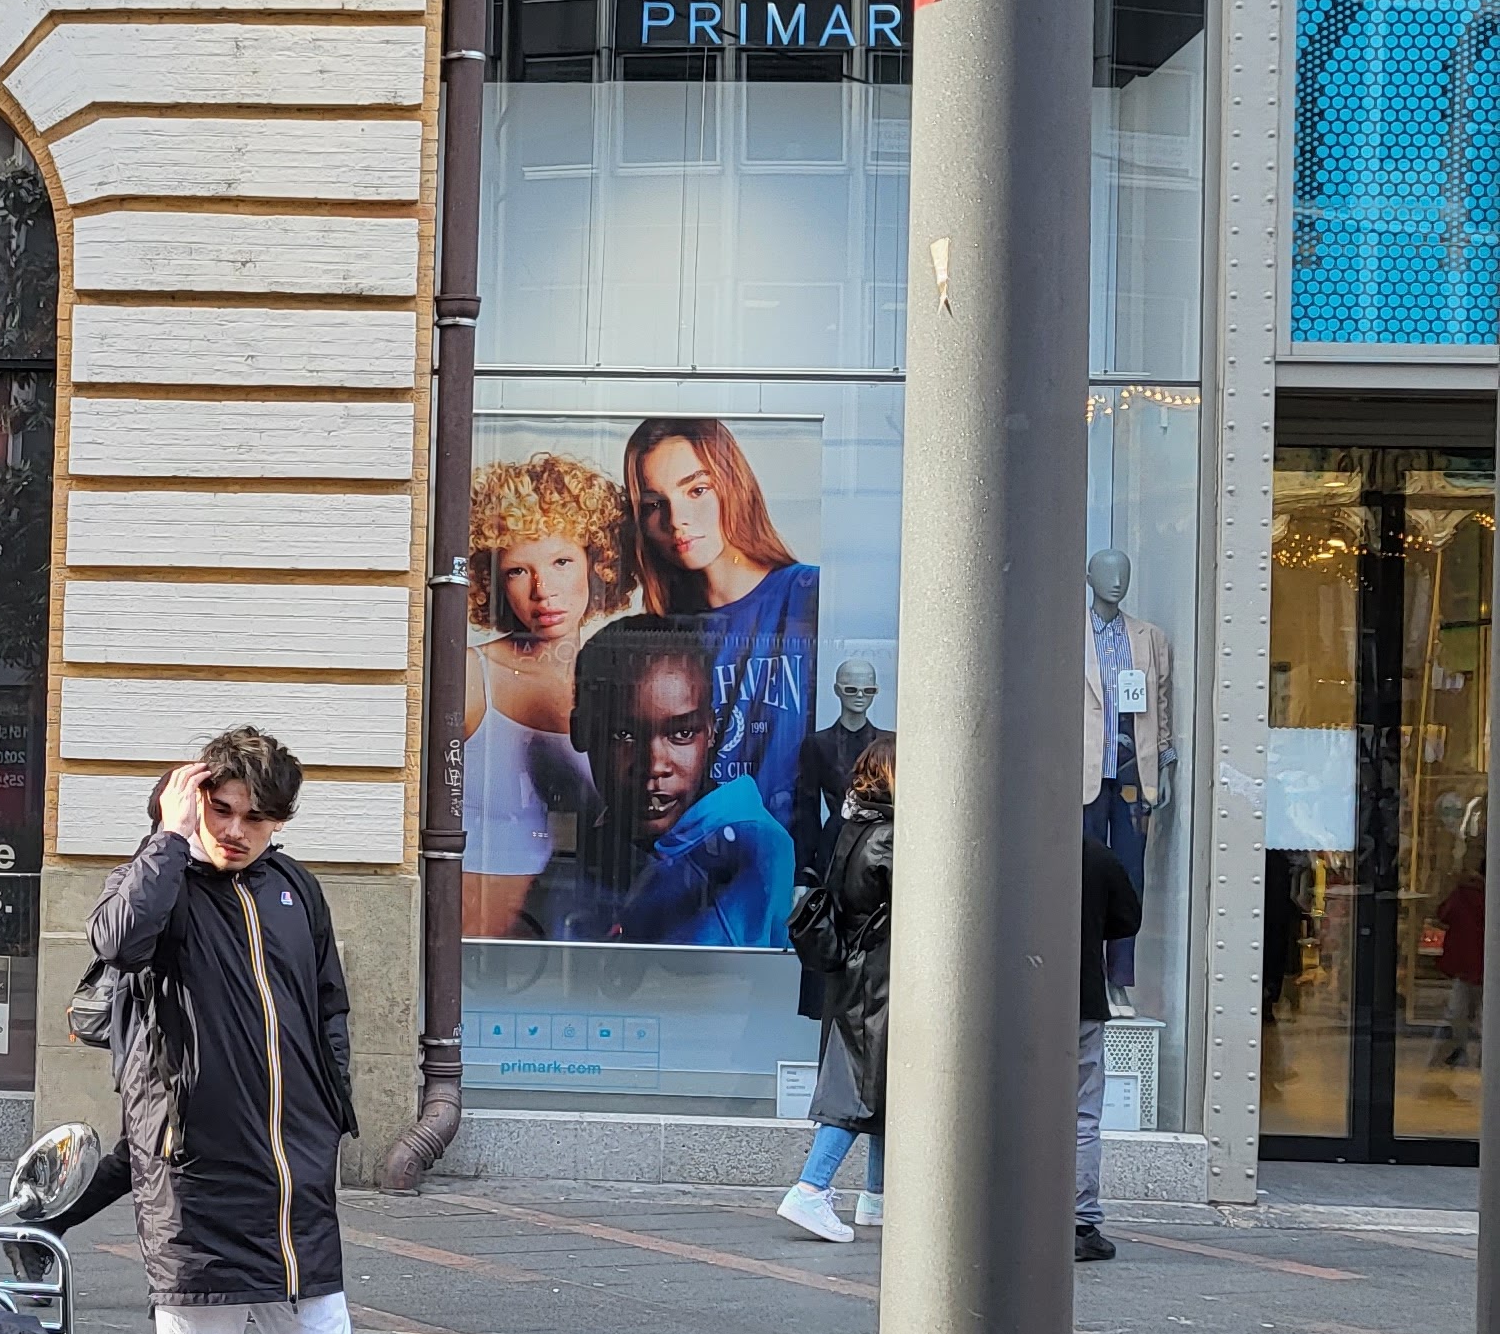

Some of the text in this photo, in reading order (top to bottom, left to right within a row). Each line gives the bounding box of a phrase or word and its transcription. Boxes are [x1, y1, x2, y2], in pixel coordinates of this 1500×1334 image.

[641, 1, 902, 47] PRIMAR
[1123, 687, 1145, 701] 16€
[501, 1059, 602, 1075] primark.com
